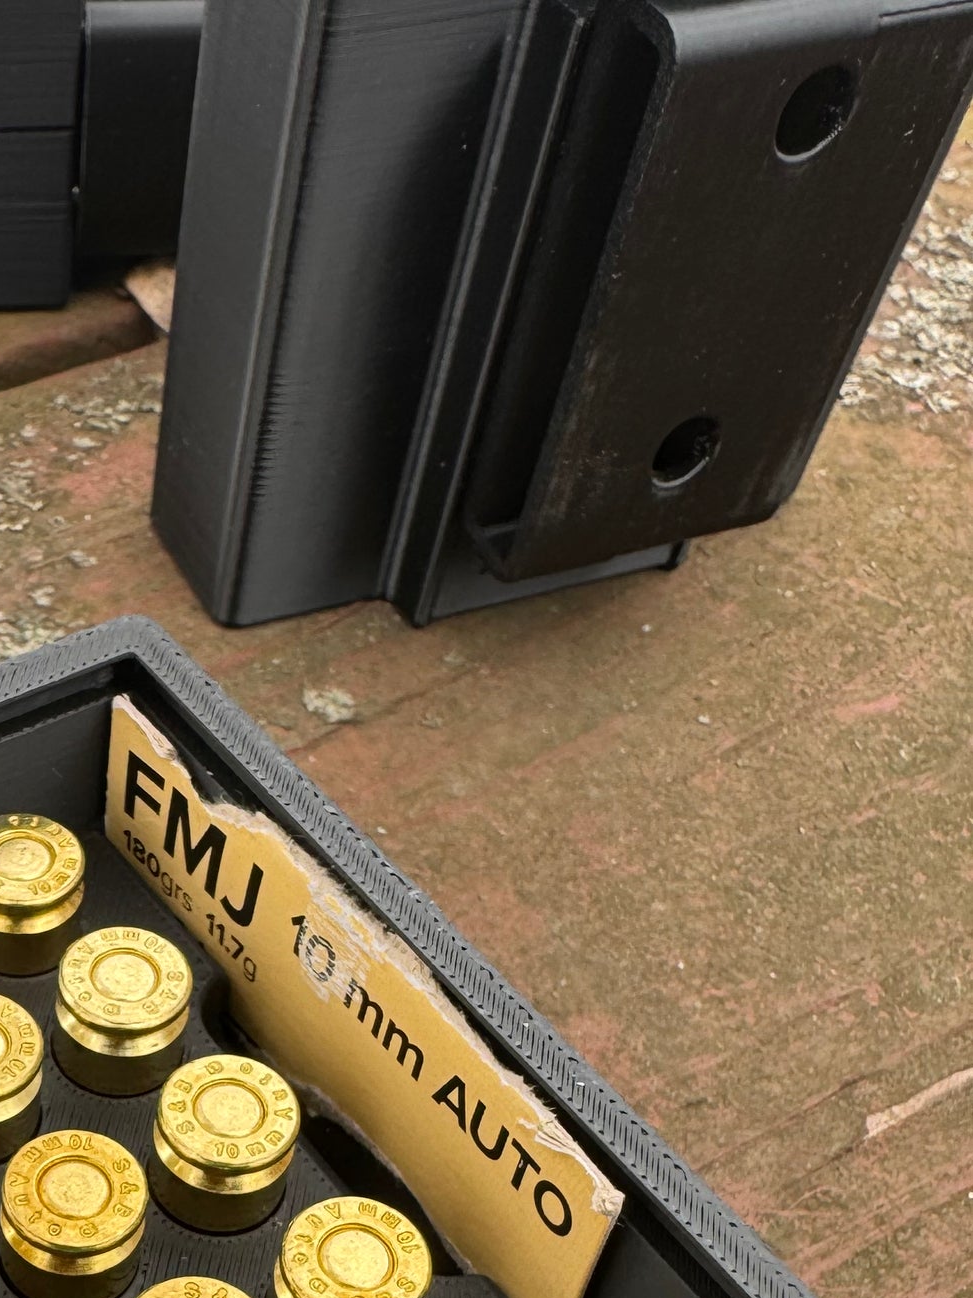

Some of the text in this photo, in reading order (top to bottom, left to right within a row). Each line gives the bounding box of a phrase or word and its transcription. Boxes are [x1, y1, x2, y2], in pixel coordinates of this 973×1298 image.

[122, 829, 258, 983] 180grs 11.7g
[124, 750, 264, 927] FMJ
[342, 977, 425, 1082] mm
[431, 1074, 573, 1237] AUTO
